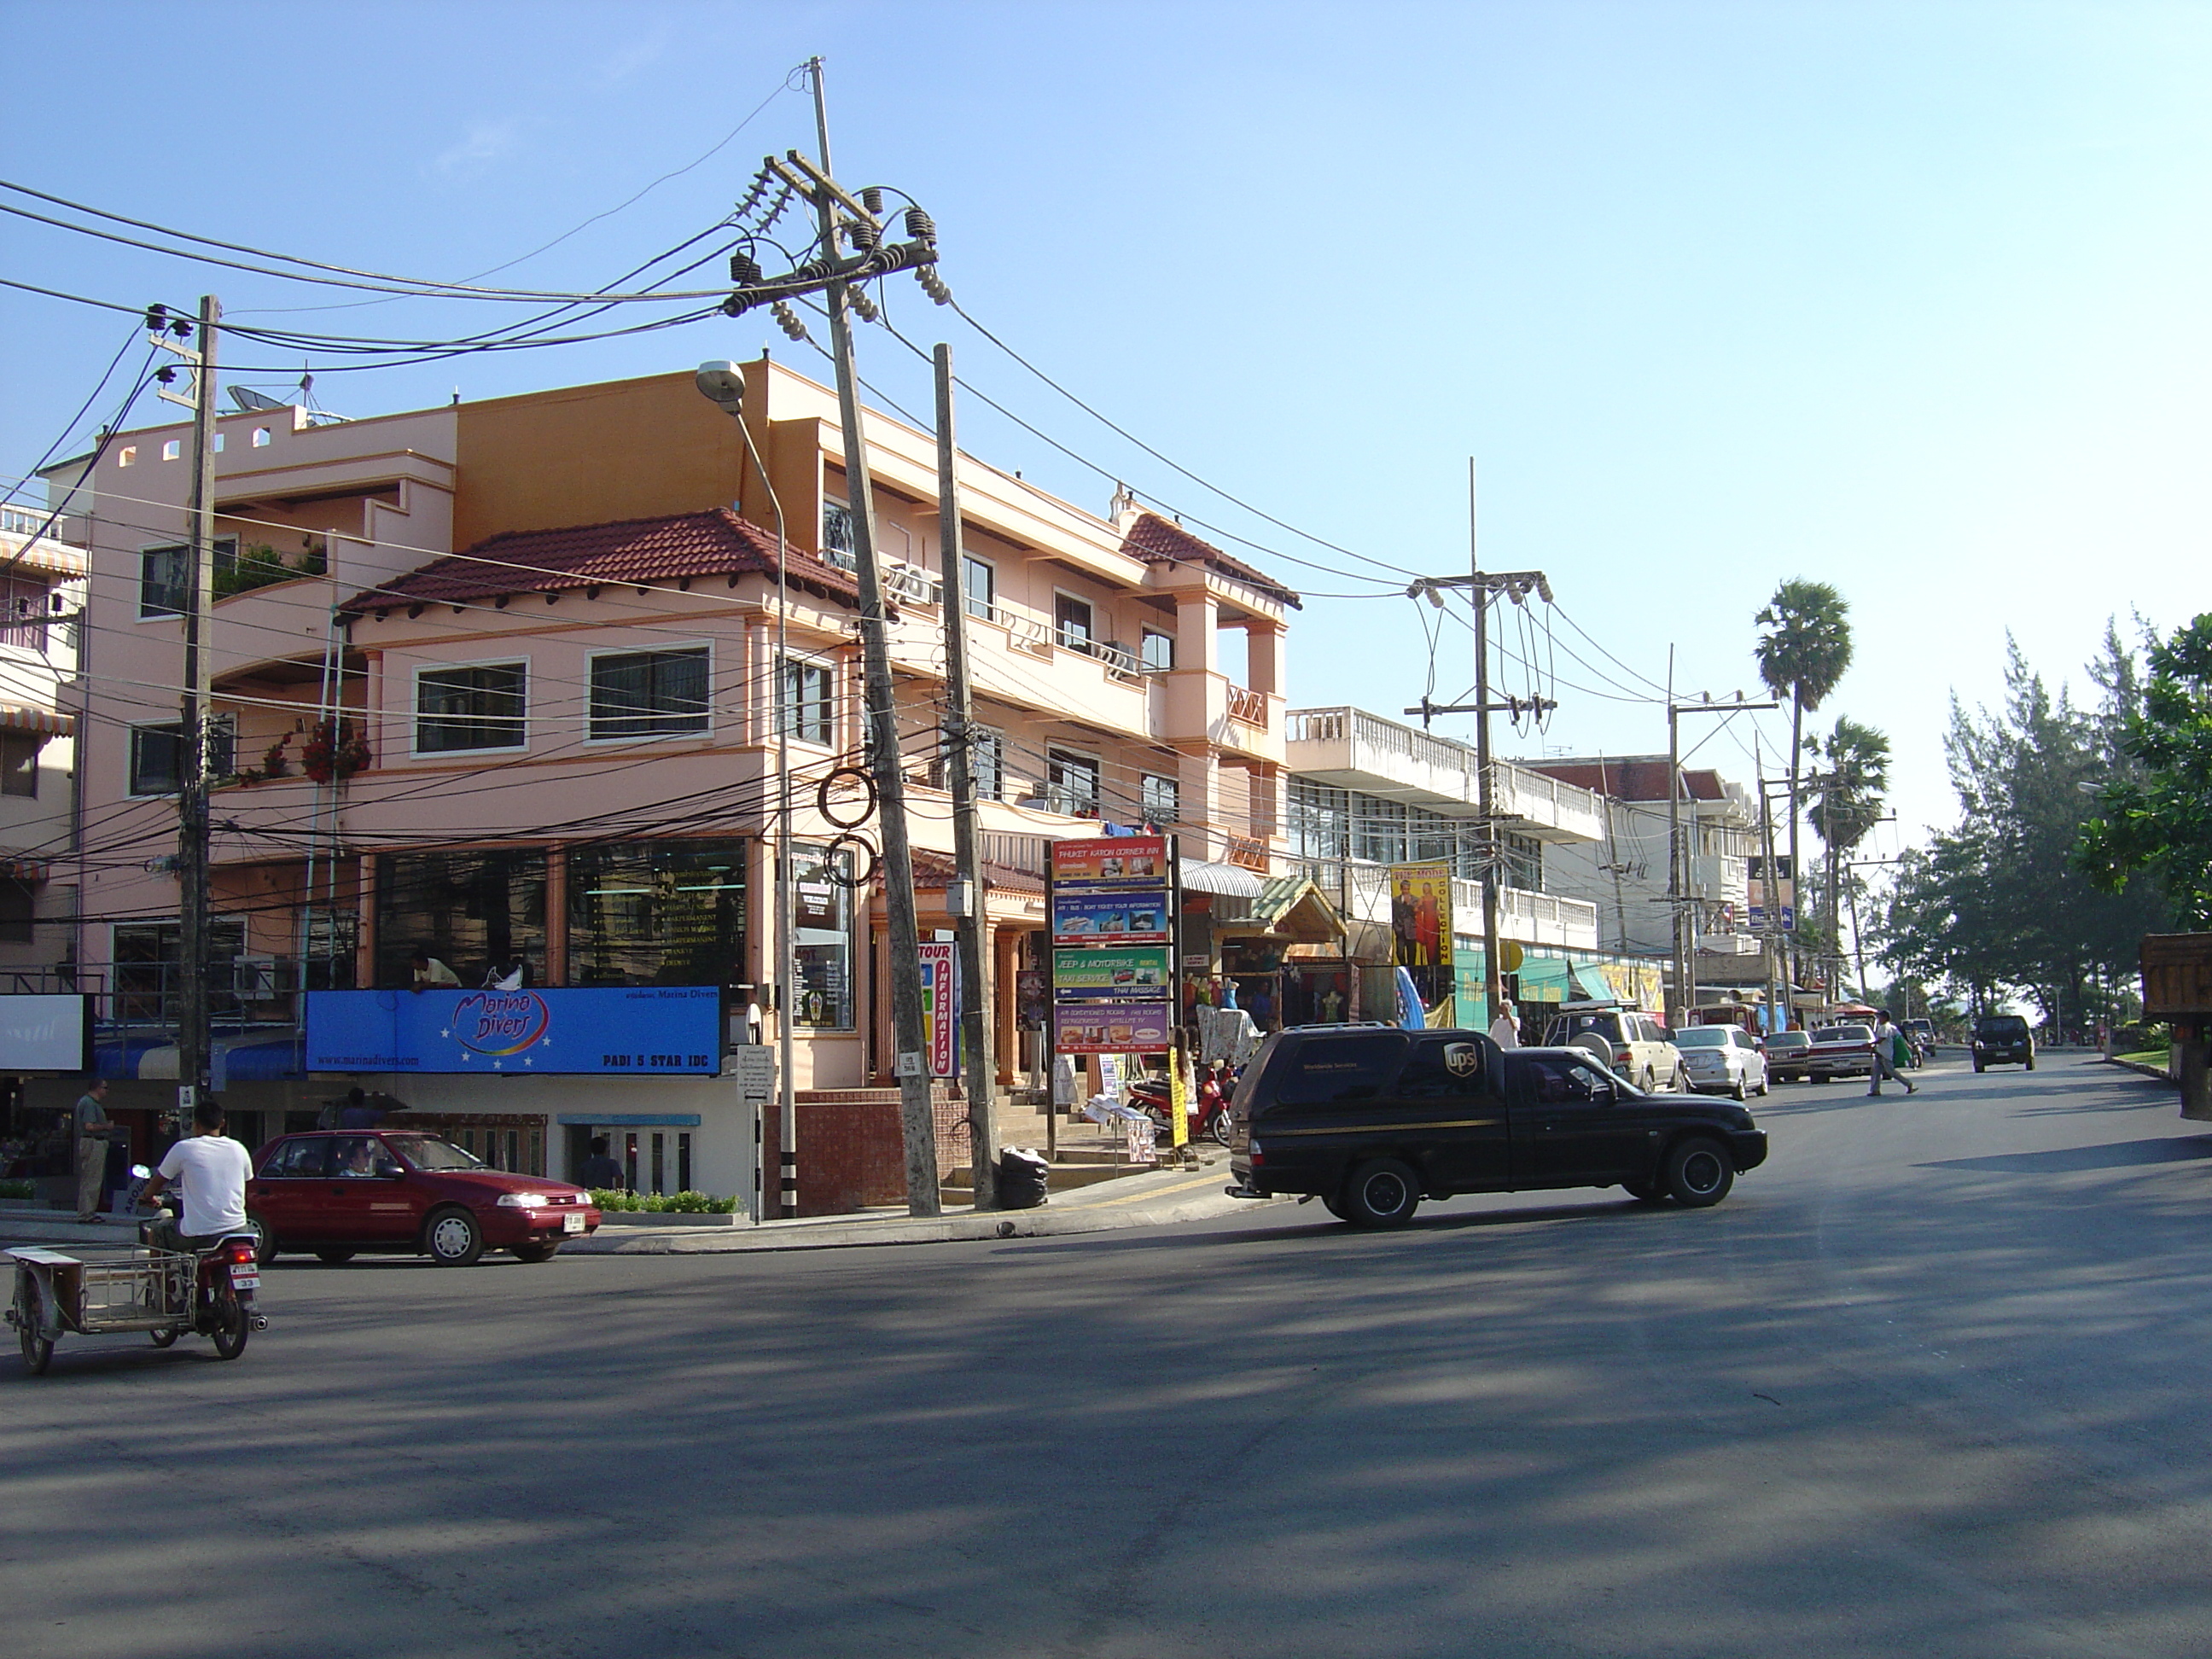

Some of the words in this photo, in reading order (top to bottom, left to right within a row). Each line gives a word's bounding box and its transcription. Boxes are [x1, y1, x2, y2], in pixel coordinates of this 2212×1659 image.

[1059, 850, 1087, 859] PHUKET
[1115, 847, 1144, 857] CORNER
[1394, 870, 1413, 880] THE
[1417, 869, 1446, 879] MODE
[1438, 881, 1448, 959] COLLECTION
[919, 946, 950, 959] TOUR
[1058, 960, 1079, 969] JEEP
[1088, 959, 1134, 969] MOTORBIKE
[1077, 974, 1109, 982] SERVICE
[658, 990, 687, 998] Marina
[690, 990, 718, 998] Divers
[461, 991, 531, 1013] Marina
[937, 963, 949, 1070] INFORMATION
[477, 1015, 531, 1040] Divers
[317, 1053, 419, 1067] www.marinadivers.com
[603, 1055, 632, 1067] PADI
[637, 1055, 644, 1066] 5
[650, 1055, 684, 1067] STAR
[688, 1054, 708, 1067] IDC
[1447, 1051, 1476, 1074] ups
